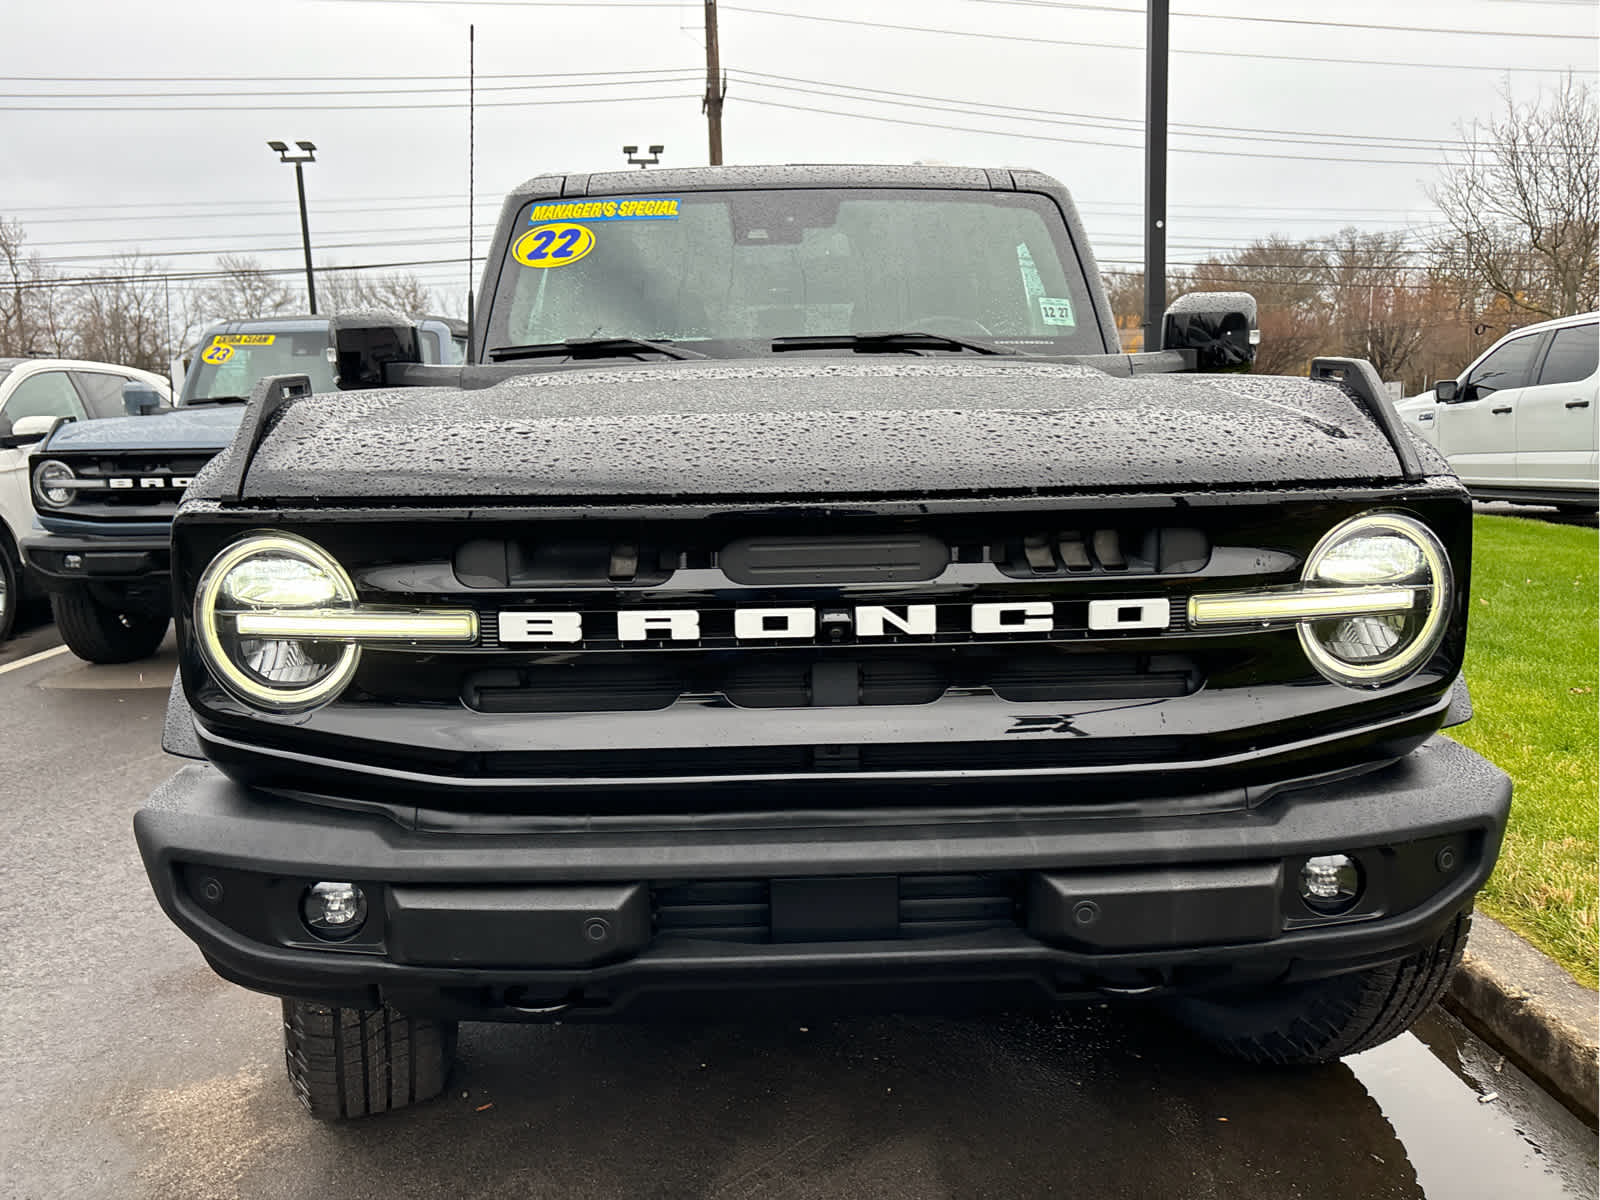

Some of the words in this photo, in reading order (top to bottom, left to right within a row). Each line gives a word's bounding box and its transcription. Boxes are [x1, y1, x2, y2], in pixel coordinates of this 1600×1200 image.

[530, 203, 618, 222] MANAGER'S
[618, 200, 679, 217] SPECIAL
[526, 228, 581, 260] 22
[1043, 307, 1056, 318] 12
[1058, 307, 1069, 318] 27
[207, 347, 230, 361] 23
[498, 598, 1170, 643] BRONCO
